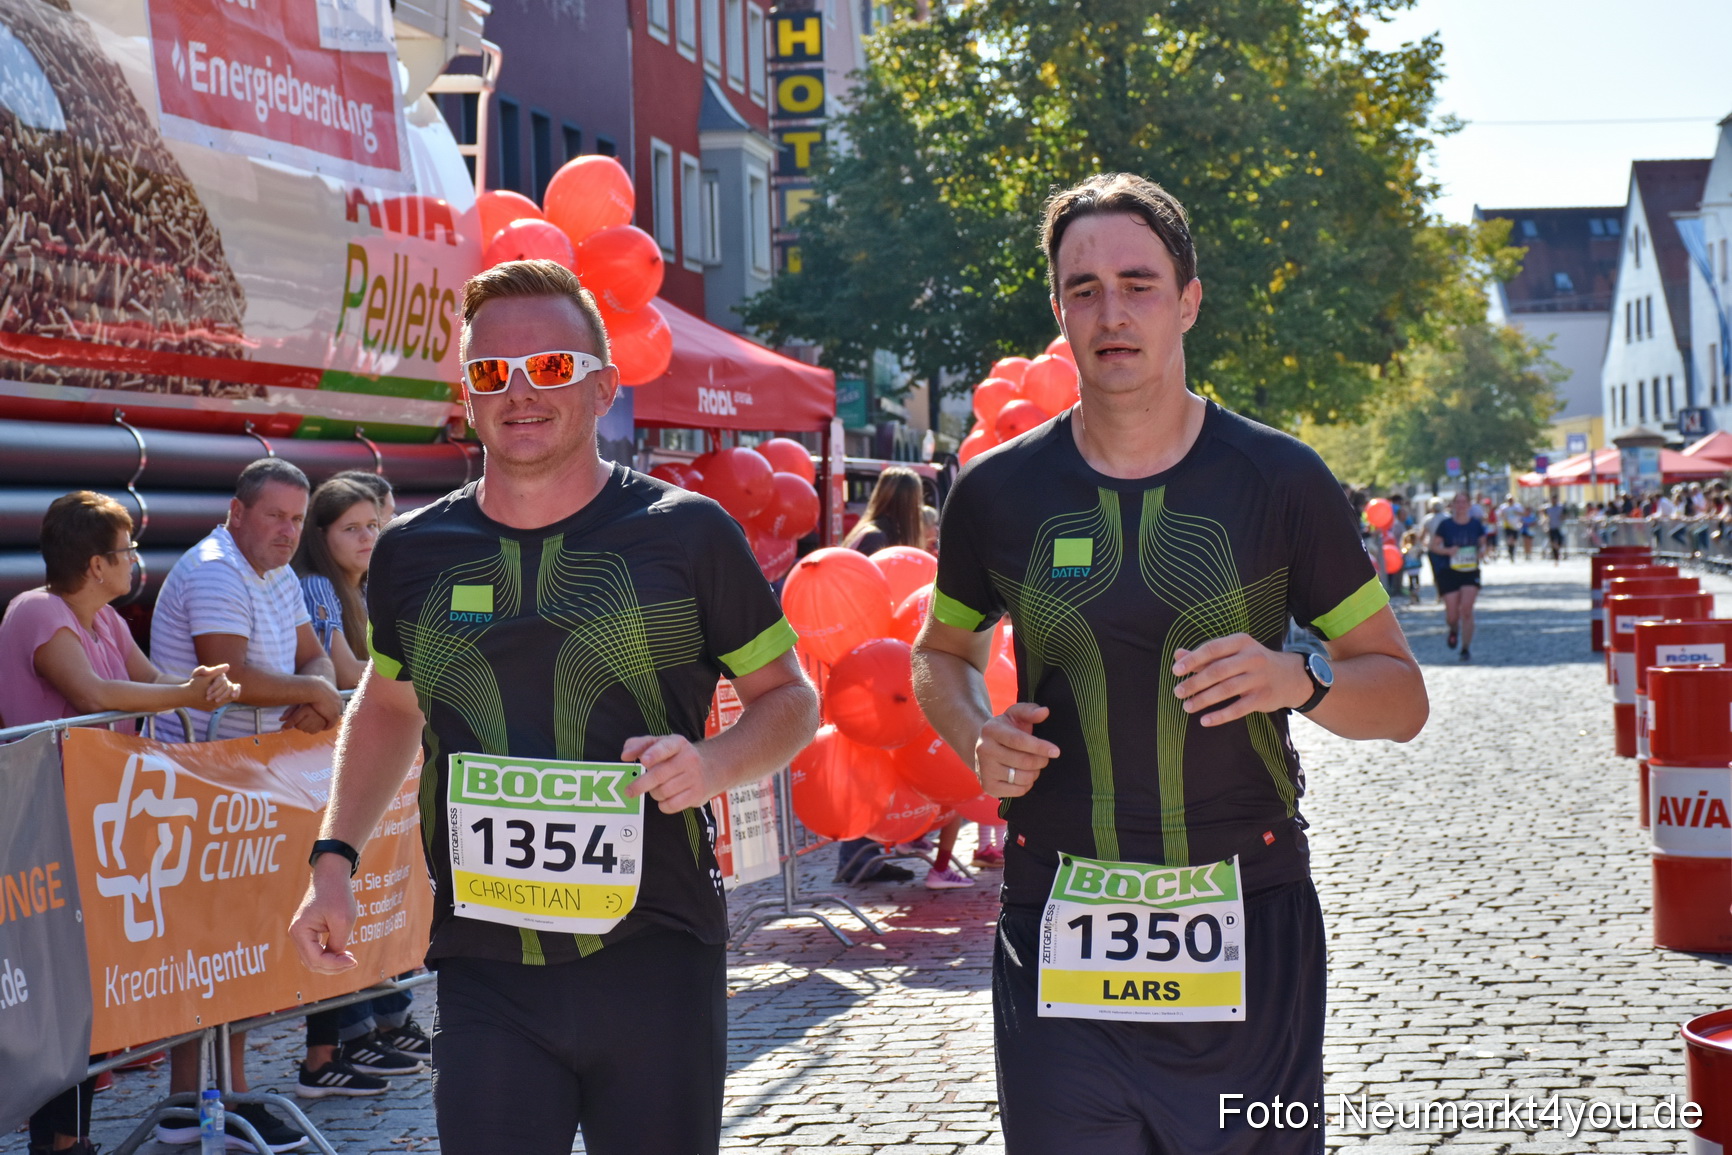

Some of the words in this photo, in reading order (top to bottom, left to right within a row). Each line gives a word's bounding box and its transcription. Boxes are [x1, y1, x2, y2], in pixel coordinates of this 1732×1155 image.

[188, 40, 379, 154] Energieberatung
[335, 242, 456, 363] Pellets
[1051, 566, 1091, 579] DATEV
[449, 611, 494, 623] DATEV
[301, 767, 334, 783] Neum
[462, 762, 626, 808] BOCK
[208, 790, 279, 835] CODE
[622, 828, 633, 839] D
[199, 833, 287, 883] CLINIC
[471, 817, 618, 875] 1354
[365, 872, 382, 890] Sie
[469, 879, 581, 911] CHRISTIAN
[1064, 861, 1224, 903] BOCK
[1067, 912, 1222, 963] 1350
[1226, 916, 1235, 926] D
[105, 941, 269, 1008] KreativAgentur
[1103, 980, 1181, 1001] LARS
